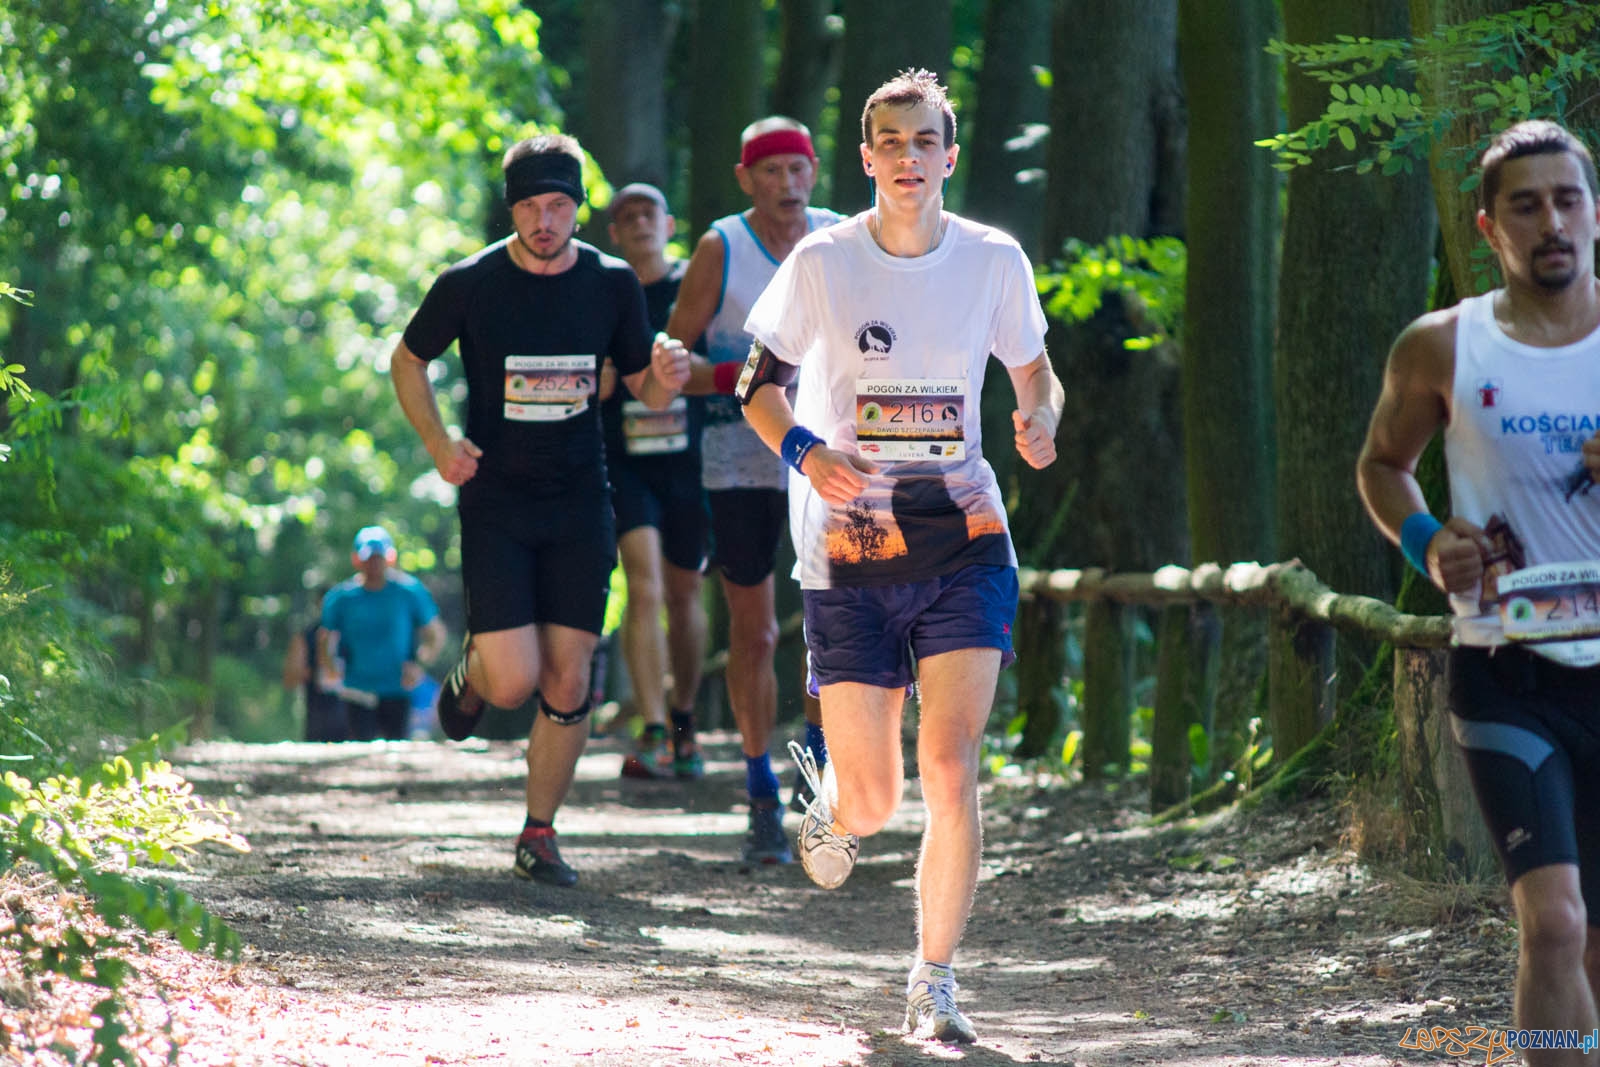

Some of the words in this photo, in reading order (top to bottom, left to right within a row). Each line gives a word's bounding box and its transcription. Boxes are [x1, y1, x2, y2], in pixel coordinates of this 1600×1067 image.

[533, 375, 569, 391] 252
[867, 384, 902, 393] POGOŃ
[890, 402, 934, 423] 216
[1546, 591, 1600, 621] 214
